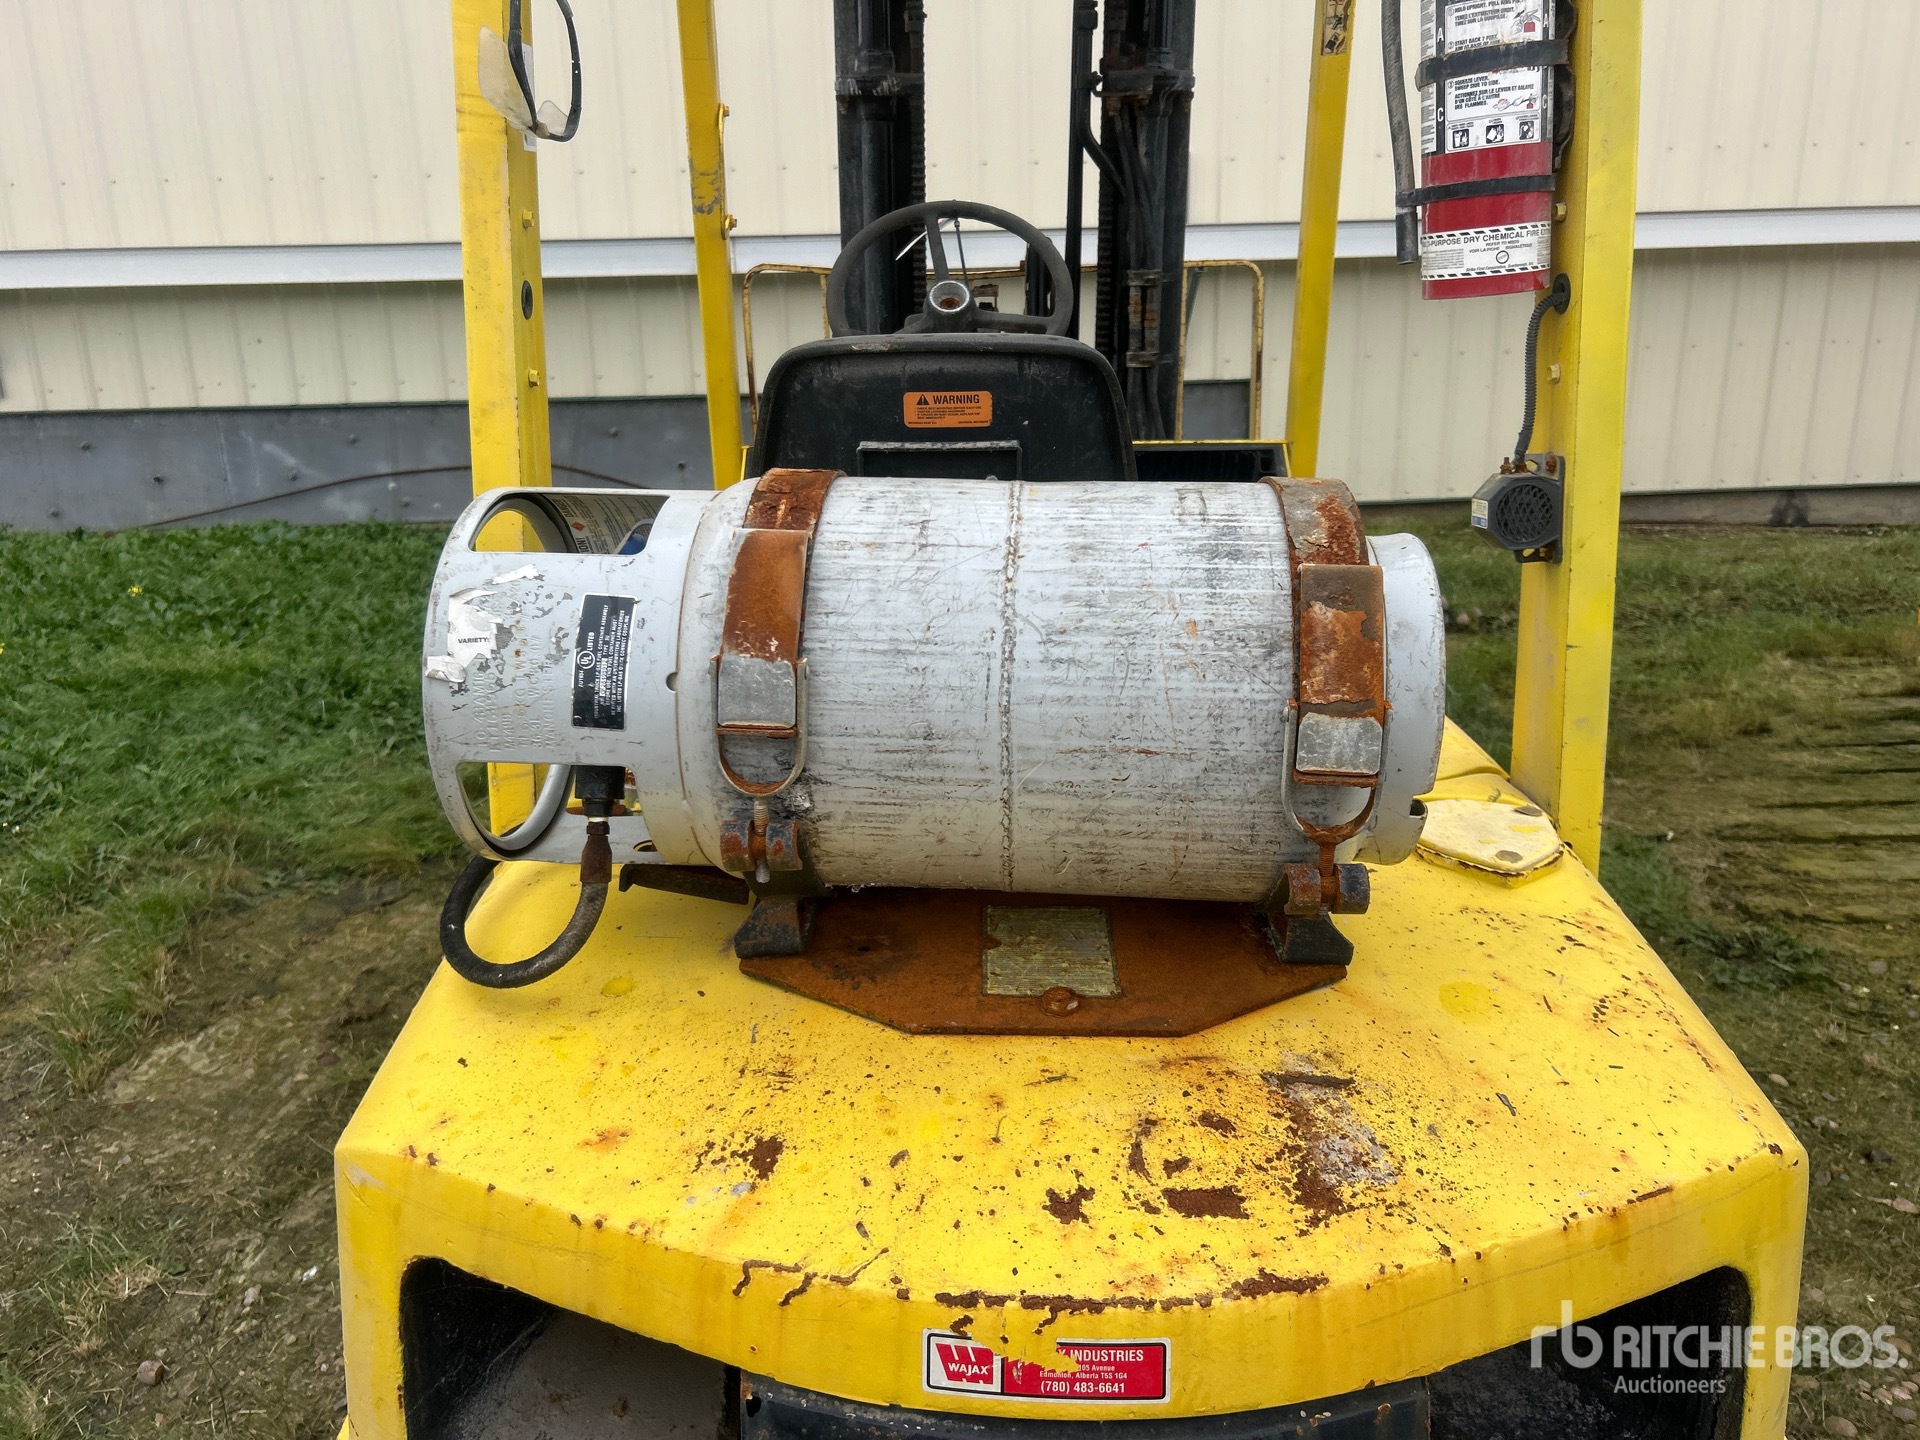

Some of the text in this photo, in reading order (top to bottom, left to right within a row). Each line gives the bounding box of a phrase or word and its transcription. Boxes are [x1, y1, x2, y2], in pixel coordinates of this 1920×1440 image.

[1437, 28, 1444, 42] A
[1437, 108, 1444, 122] C
[1483, 231, 1524, 242] CHEMICAL
[933, 394, 980, 404] WARNING
[1071, 1349, 1144, 1362] INDUSTRIES
[948, 1362, 988, 1376] WAJAX
[1041, 1381, 1124, 1394] (780) 483-6641
